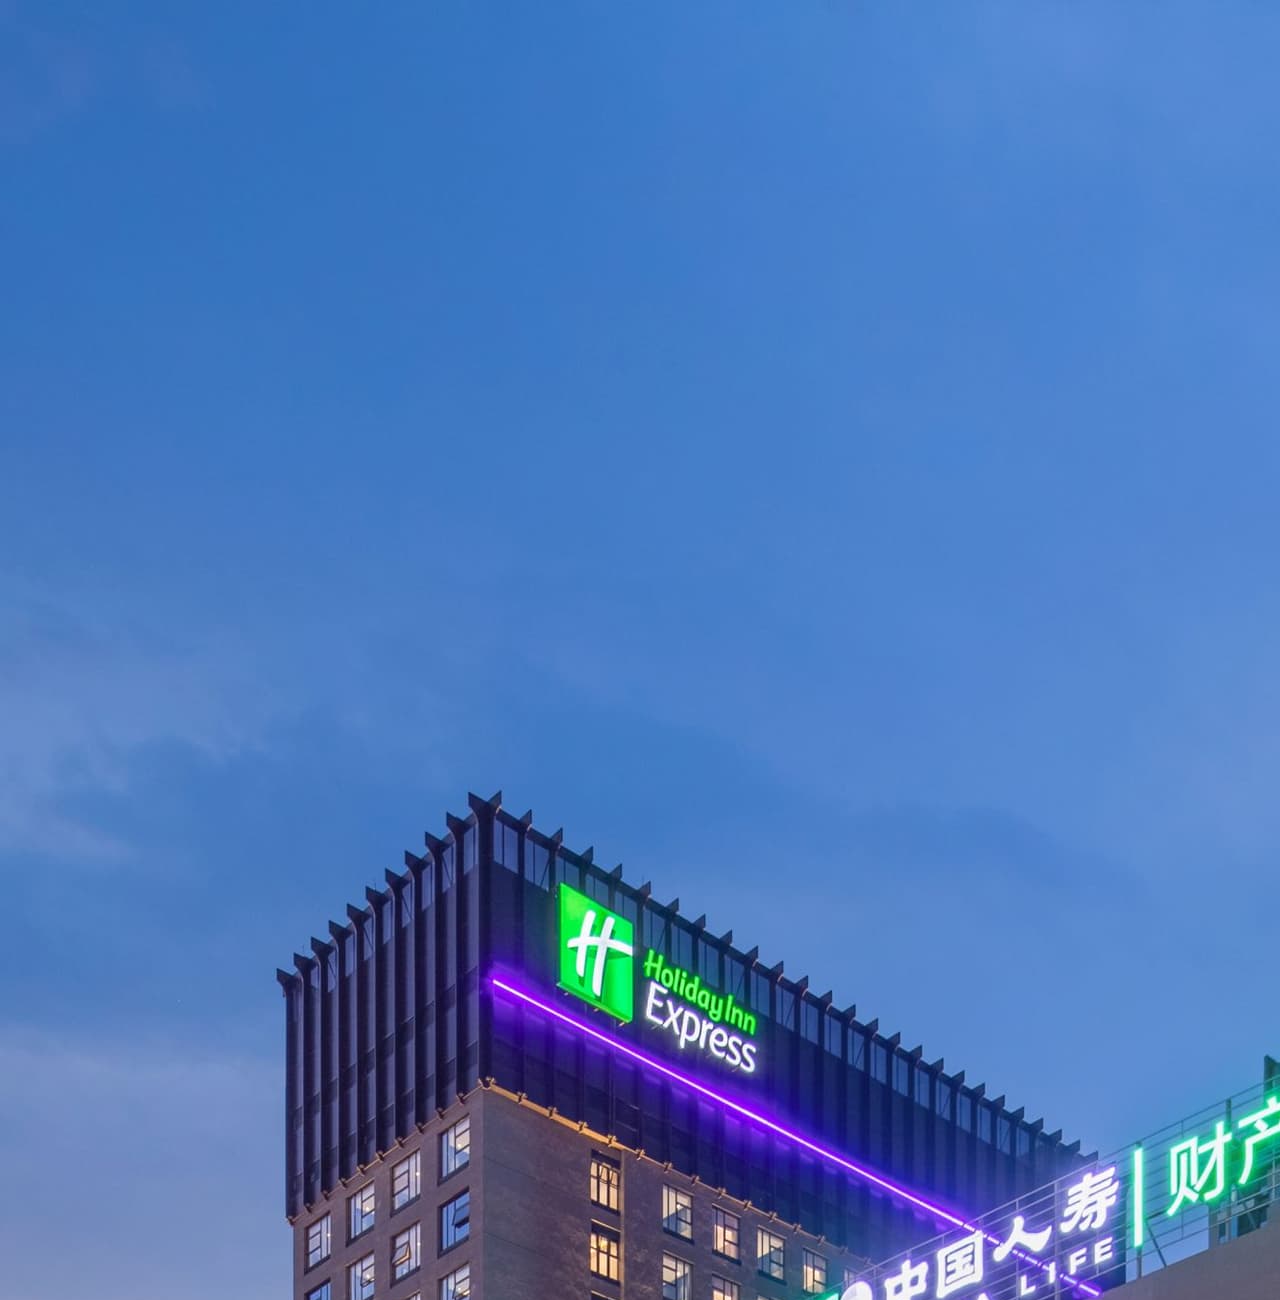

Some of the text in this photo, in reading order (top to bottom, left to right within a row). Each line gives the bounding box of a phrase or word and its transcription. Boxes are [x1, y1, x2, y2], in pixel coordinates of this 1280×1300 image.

[644, 947, 756, 1035] Holiday Inn
[645, 981, 757, 1073] Express
[1020, 1236, 1113, 1296] LIFE
